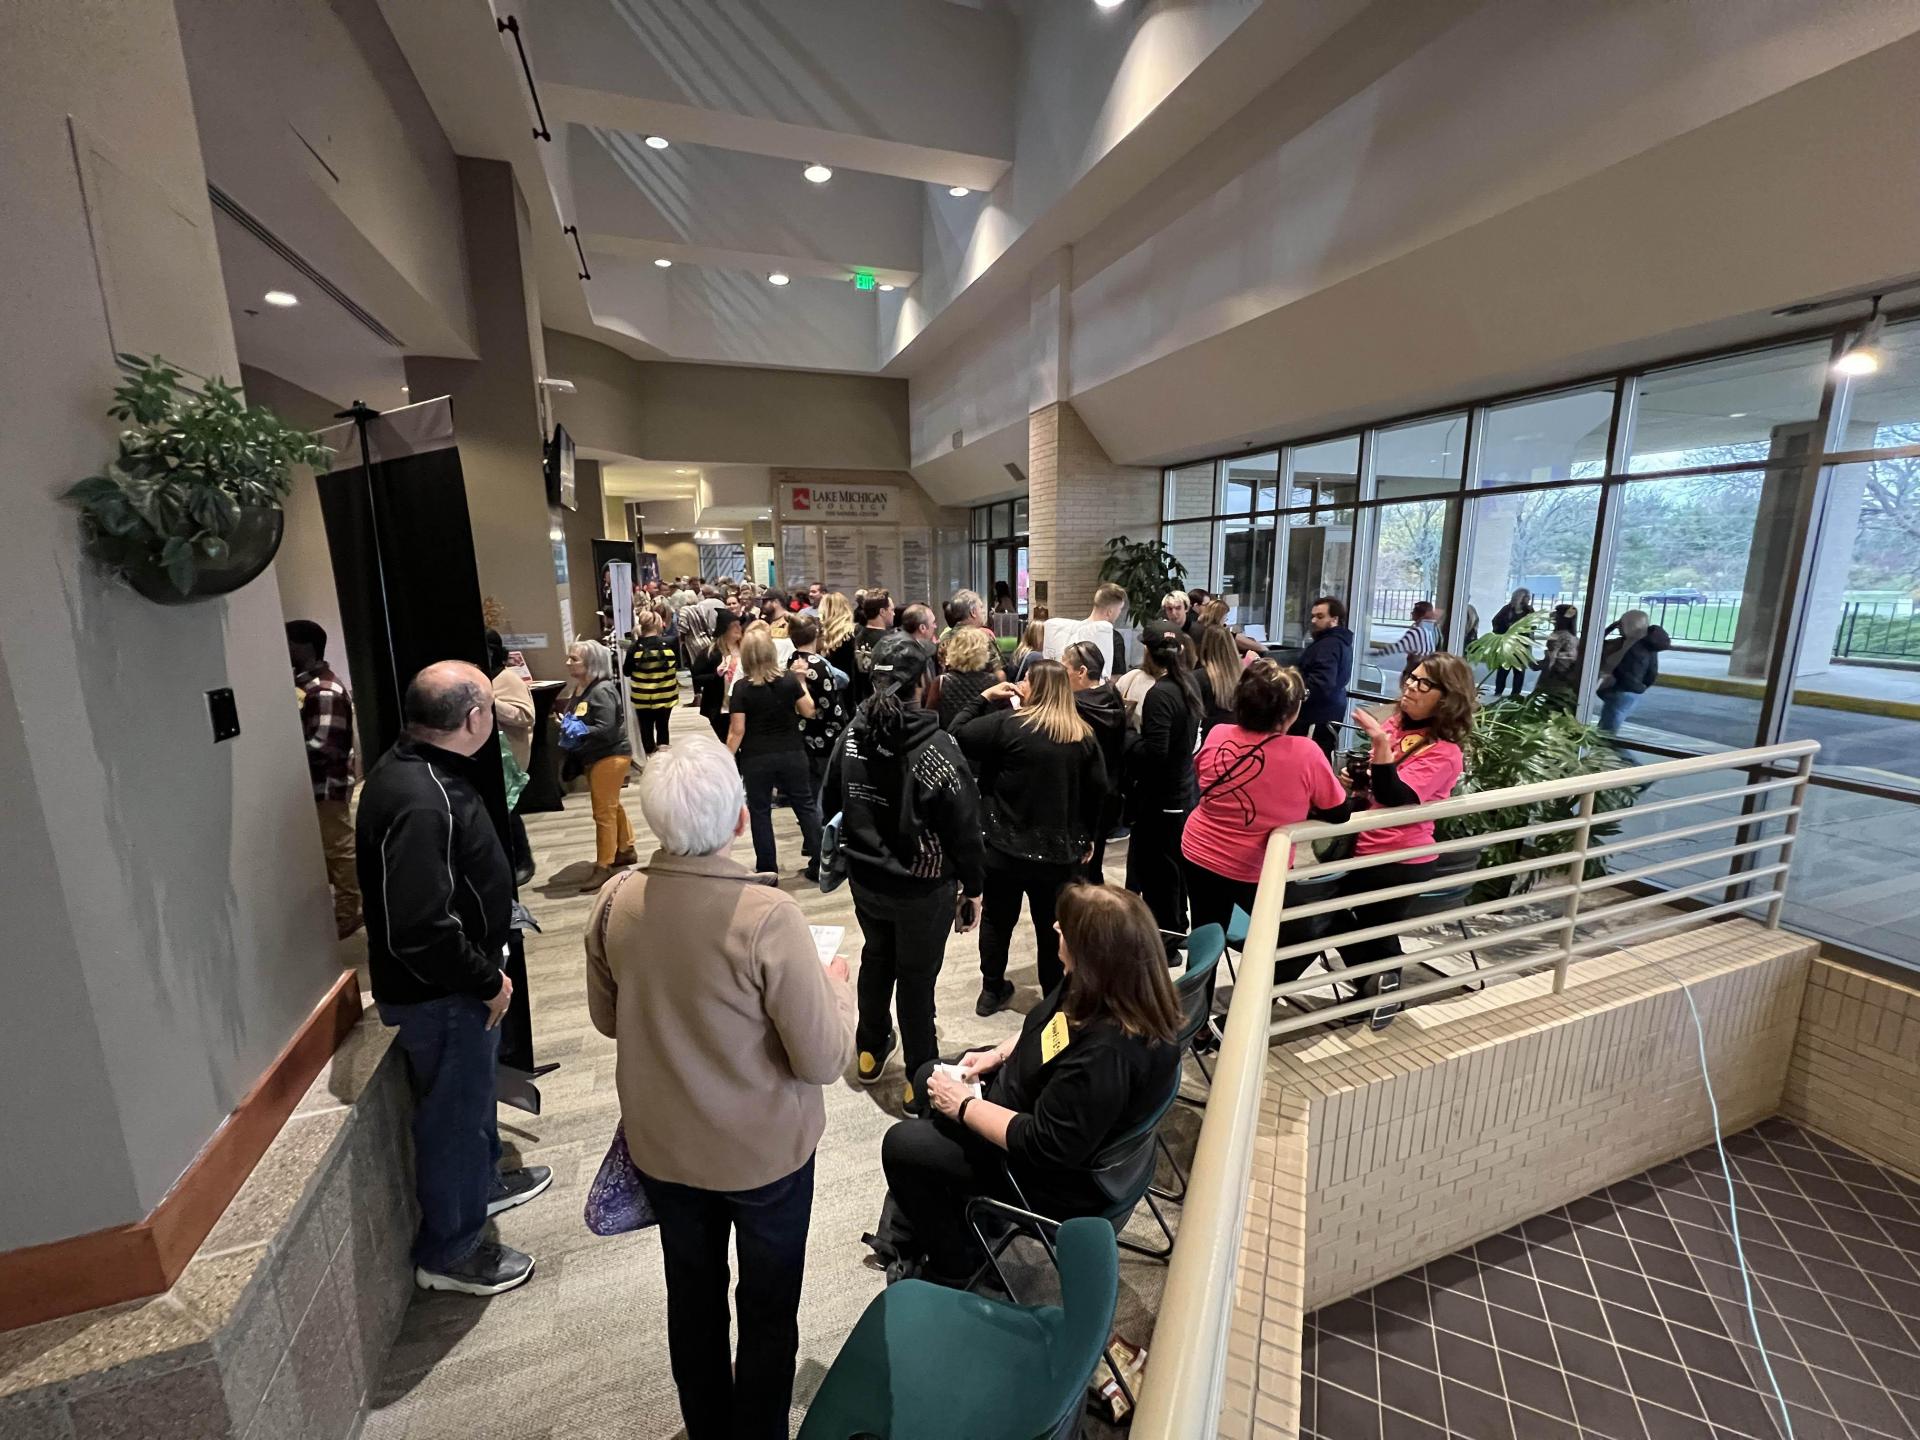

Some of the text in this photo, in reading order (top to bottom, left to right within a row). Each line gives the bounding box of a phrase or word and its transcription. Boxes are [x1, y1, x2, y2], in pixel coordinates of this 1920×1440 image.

[857, 275, 874, 289] EXIT
[812, 490, 888, 503] LAKE MICHIGAN
[816, 502, 886, 511] COLLEGE
